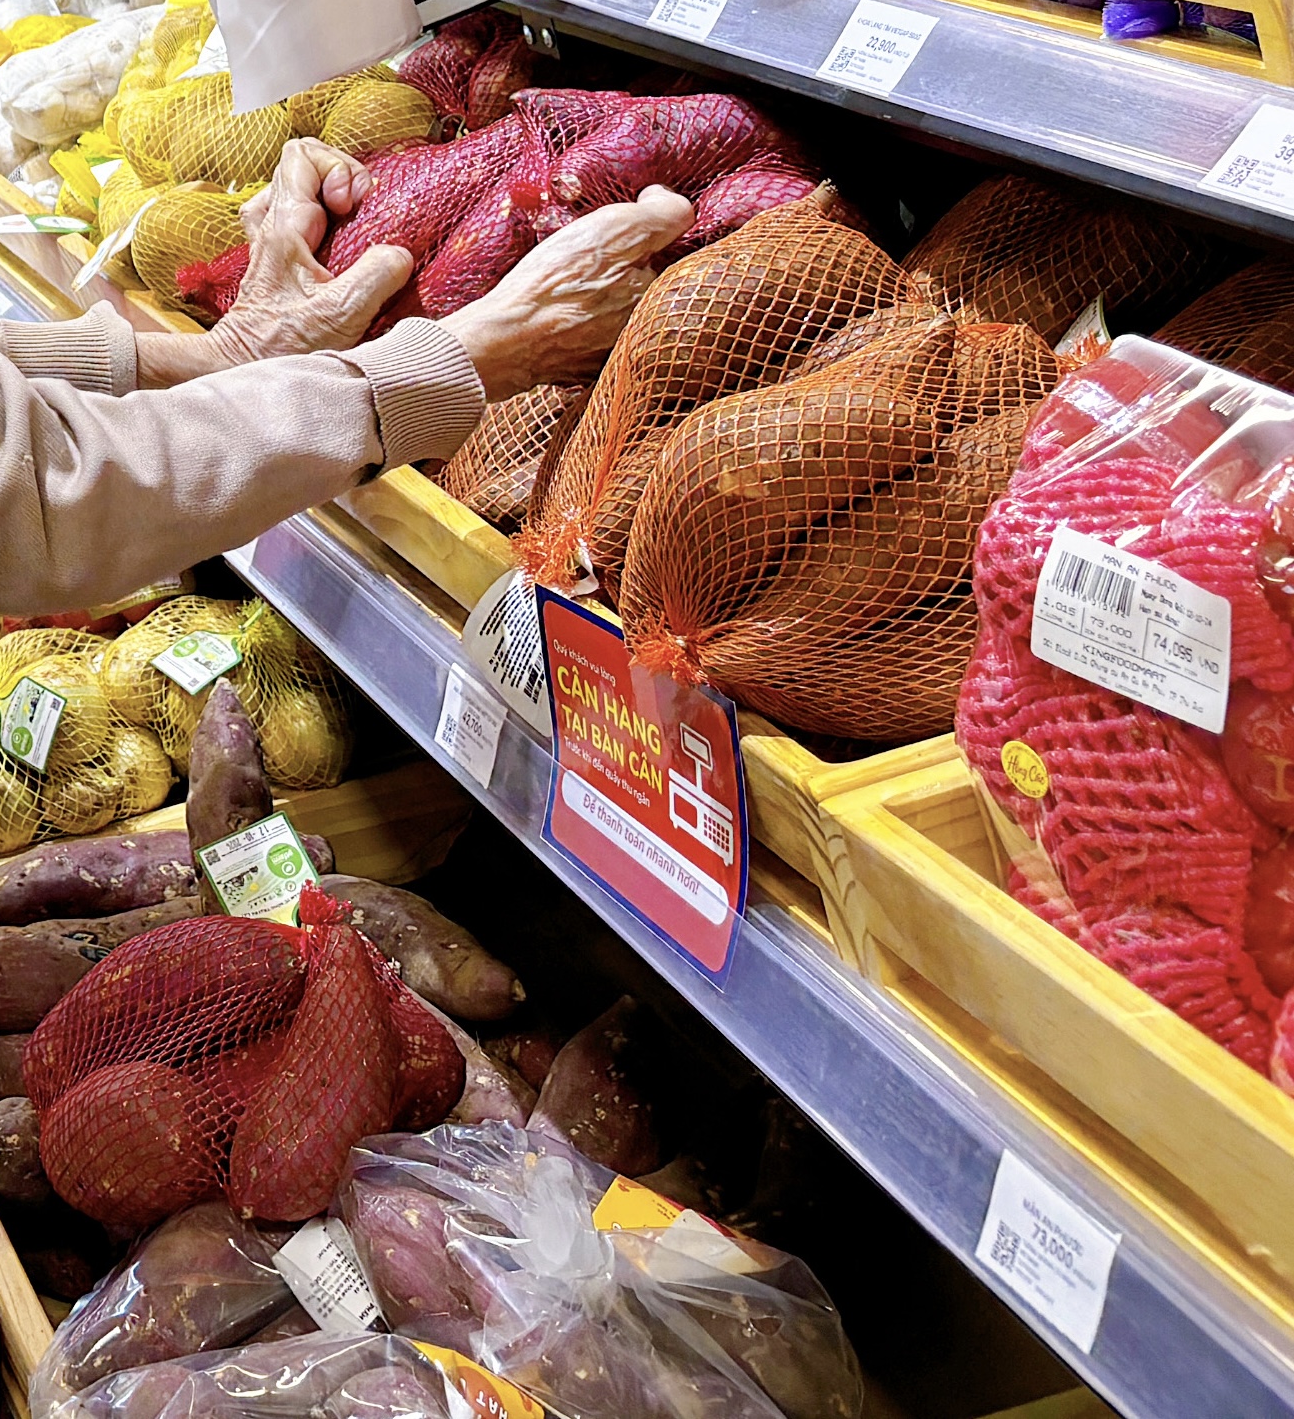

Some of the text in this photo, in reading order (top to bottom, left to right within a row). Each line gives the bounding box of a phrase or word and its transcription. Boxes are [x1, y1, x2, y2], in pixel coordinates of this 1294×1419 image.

[866, 35, 897, 54] 22,900
[1042, 596, 1077, 616] 1.015
[1090, 615, 1133, 640] 73.000
[553, 639, 616, 688] Quý khách vui lòng
[557, 665, 661, 757] CÂN HÀNG
[562, 703, 663, 795] TẠI BÀN CÂN
[564, 735, 581, 759] Trước
[582, 747, 592, 766] khi
[592, 754, 605, 773] đến
[621, 774, 633, 795] thu
[633, 786, 651, 808] ngân
[582, 791, 700, 896] Để thanh toán nhanh hơn!
[1031, 1221, 1074, 1270] 73,000
